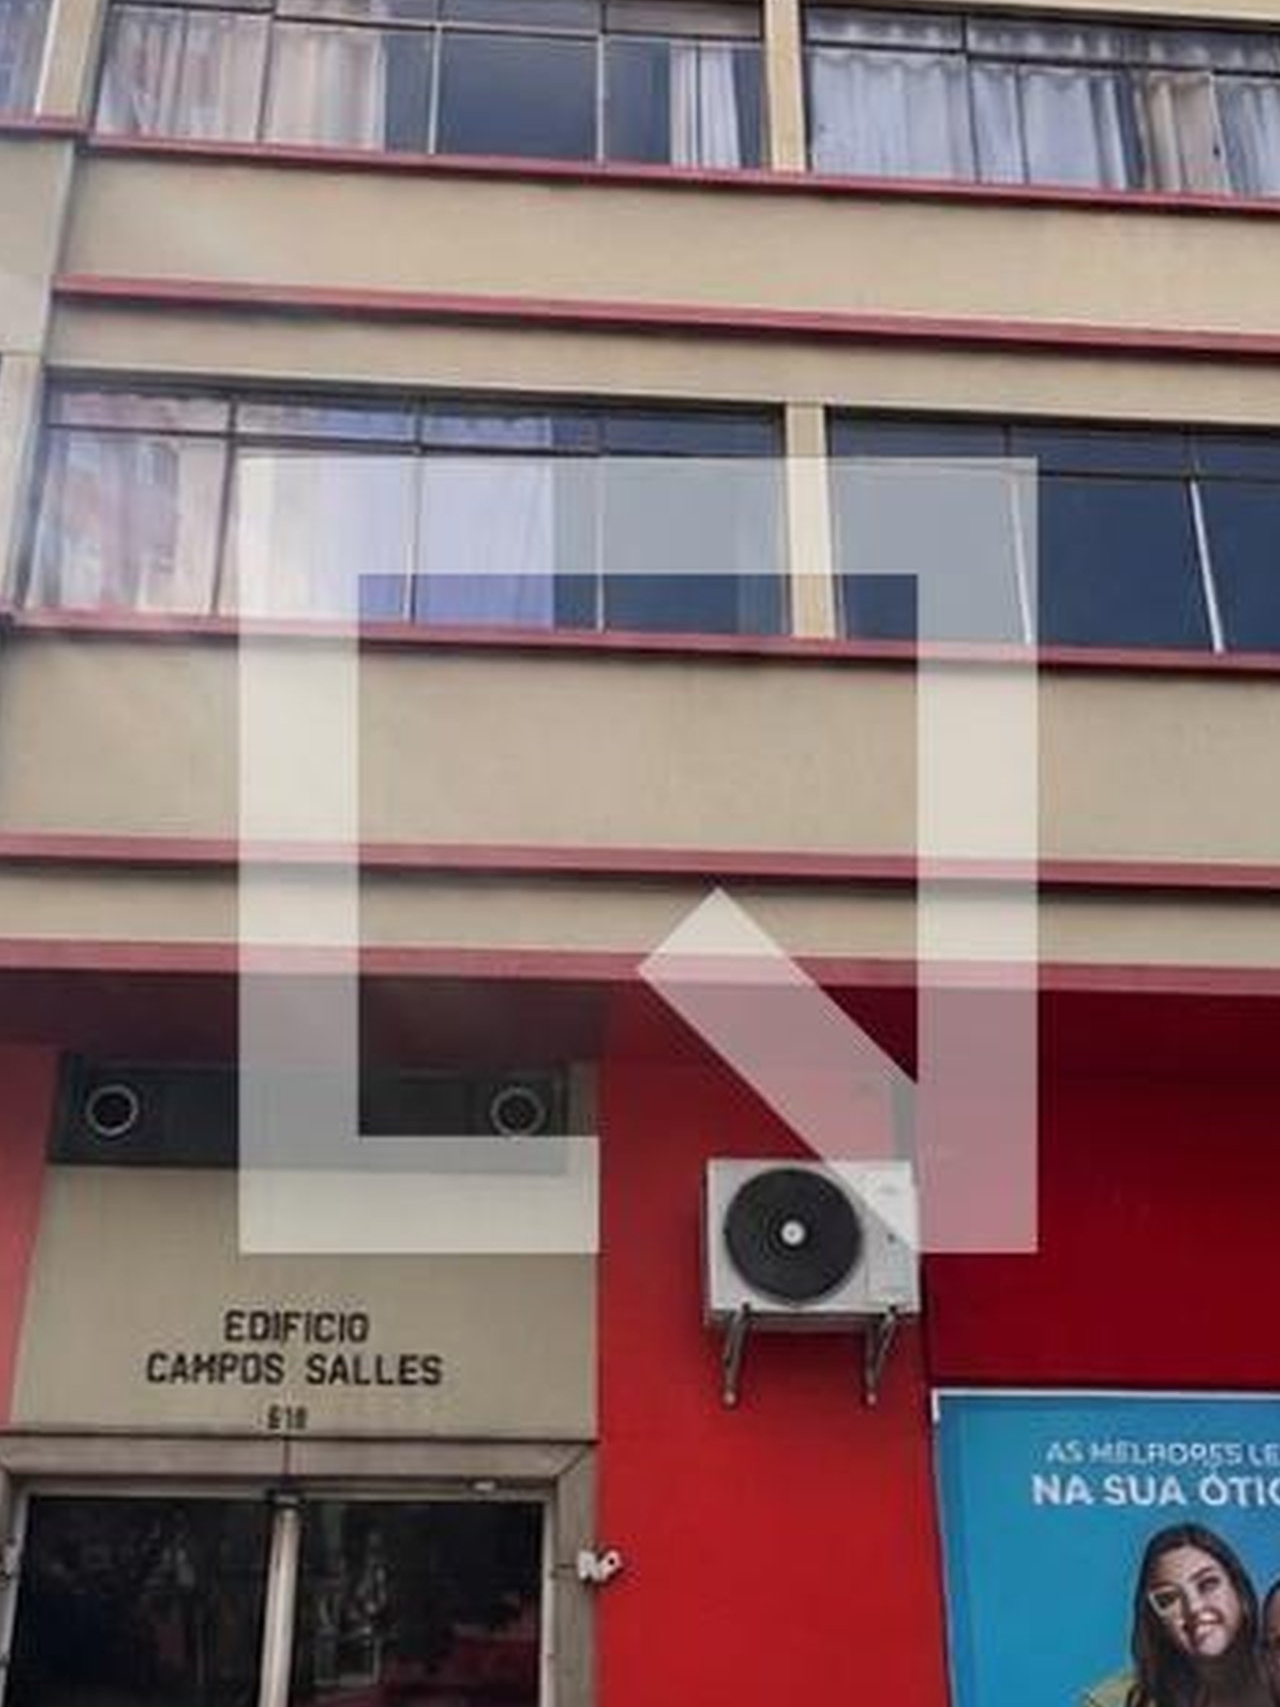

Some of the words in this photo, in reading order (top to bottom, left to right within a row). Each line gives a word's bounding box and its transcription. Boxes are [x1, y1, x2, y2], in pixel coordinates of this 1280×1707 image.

[146, 1351, 285, 1384] CAMPOS
[305, 1354, 443, 1386] SALLES
[1046, 1441, 1084, 1464] AS
[1088, 1441, 1243, 1467] MELHORES
[1032, 1473, 1094, 1507] NA
[1103, 1474, 1187, 1507] SUA
